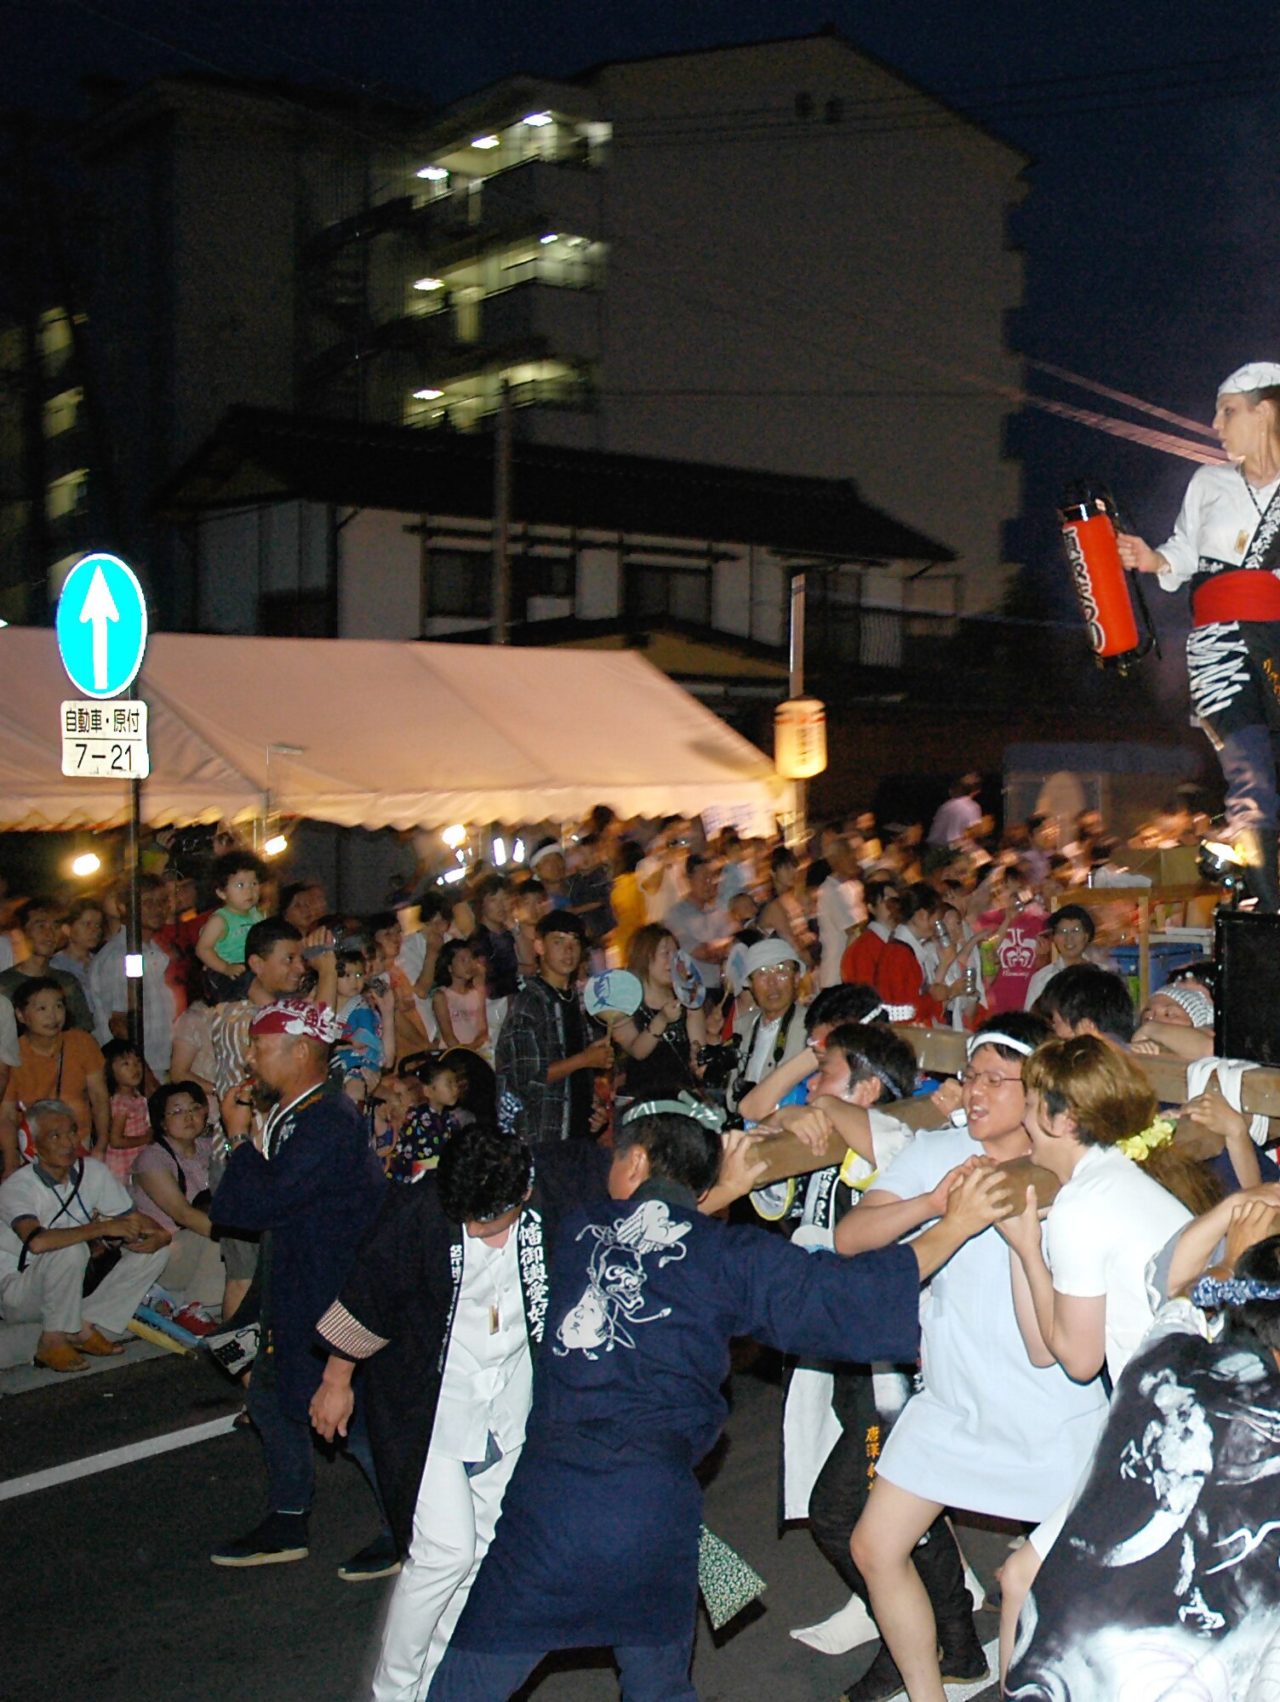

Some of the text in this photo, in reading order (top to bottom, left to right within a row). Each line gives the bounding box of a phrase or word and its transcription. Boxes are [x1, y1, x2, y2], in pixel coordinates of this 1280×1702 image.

[65, 708, 140, 733] 自動車・原付
